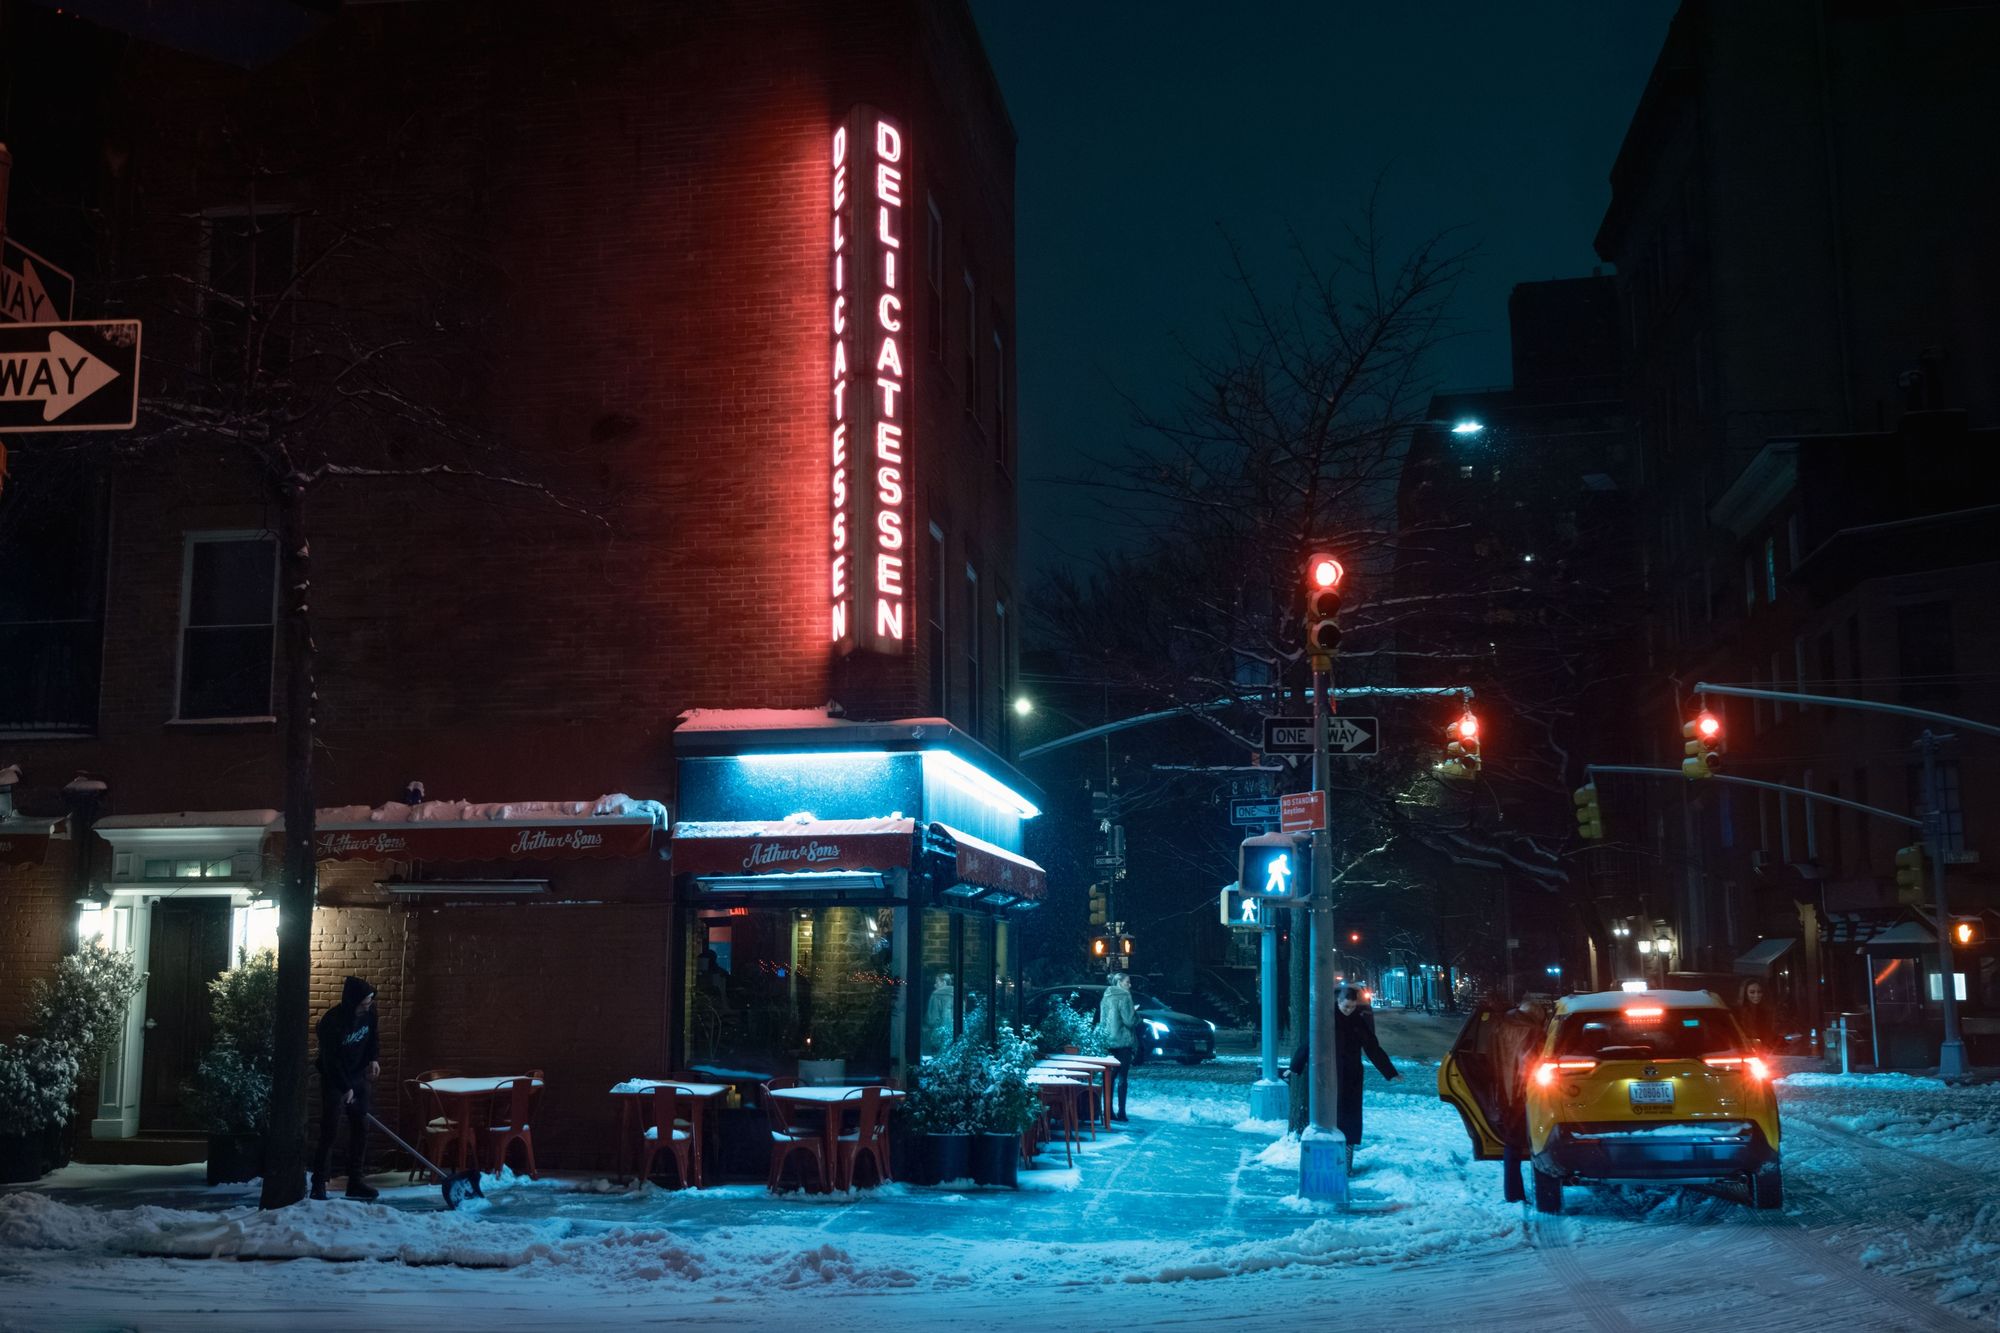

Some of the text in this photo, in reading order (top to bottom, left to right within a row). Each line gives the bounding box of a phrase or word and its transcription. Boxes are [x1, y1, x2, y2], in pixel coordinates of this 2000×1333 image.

[0, 357, 88, 396] WAY
[832, 125, 846, 643] DELICATESSEN
[876, 120, 902, 641] DELICATESSEN
[1276, 729, 1358, 743] ONE WAY
[1238, 804, 1281, 817] ONE WA
[1283, 796, 1319, 807] NO STANDING
[1283, 807, 1306, 816] Anytime
[317, 833, 370, 854] Arthur
[376, 833, 407, 852] Sons
[511, 831, 565, 854] Arthur
[572, 829, 602, 849] Sons
[743, 843, 801, 868] Arthur
[806, 841, 841, 862] Sons
